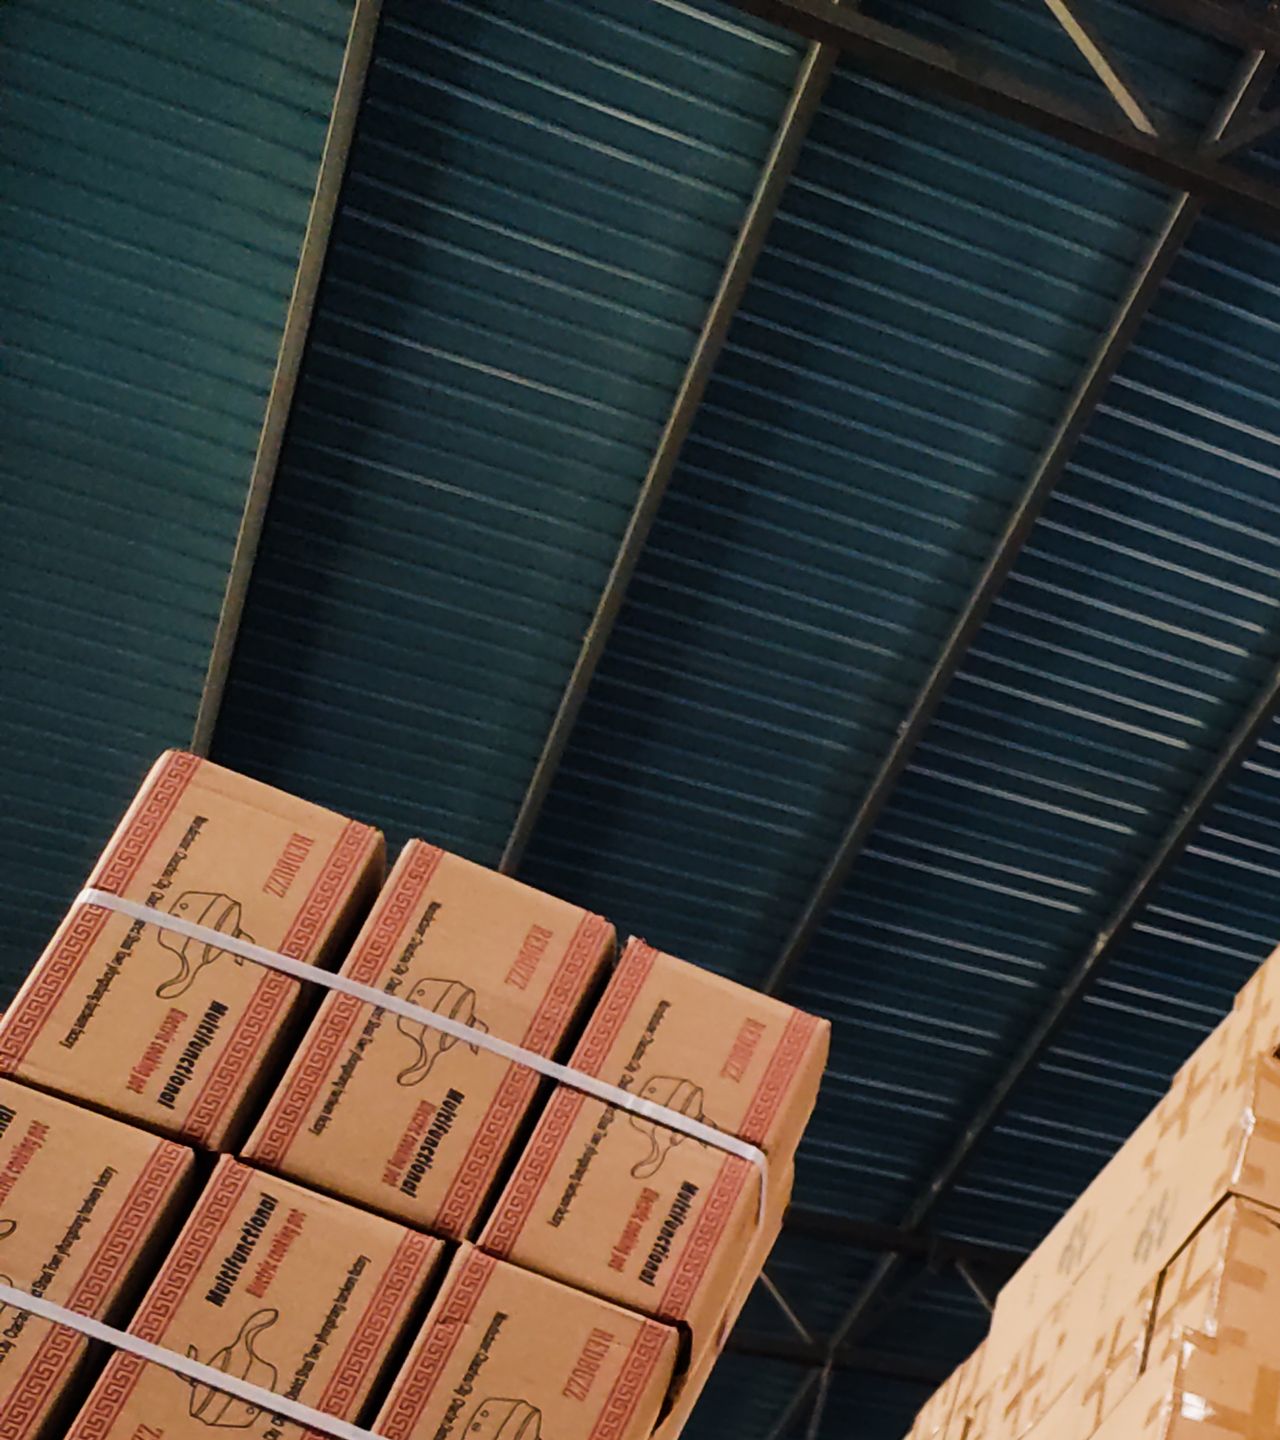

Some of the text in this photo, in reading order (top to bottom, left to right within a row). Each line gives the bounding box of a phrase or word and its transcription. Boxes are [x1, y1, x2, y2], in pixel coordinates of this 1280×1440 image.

[263, 833, 314, 898] REDBUZZ
[157, 1000, 228, 1110] Multifunctional
[400, 1088, 465, 1198] Multifunctional
[205, 1192, 278, 1307] Multifunctional
[638, 1181, 699, 1287] Multifunctional
[562, 1328, 614, 1402] REDBUZZ
